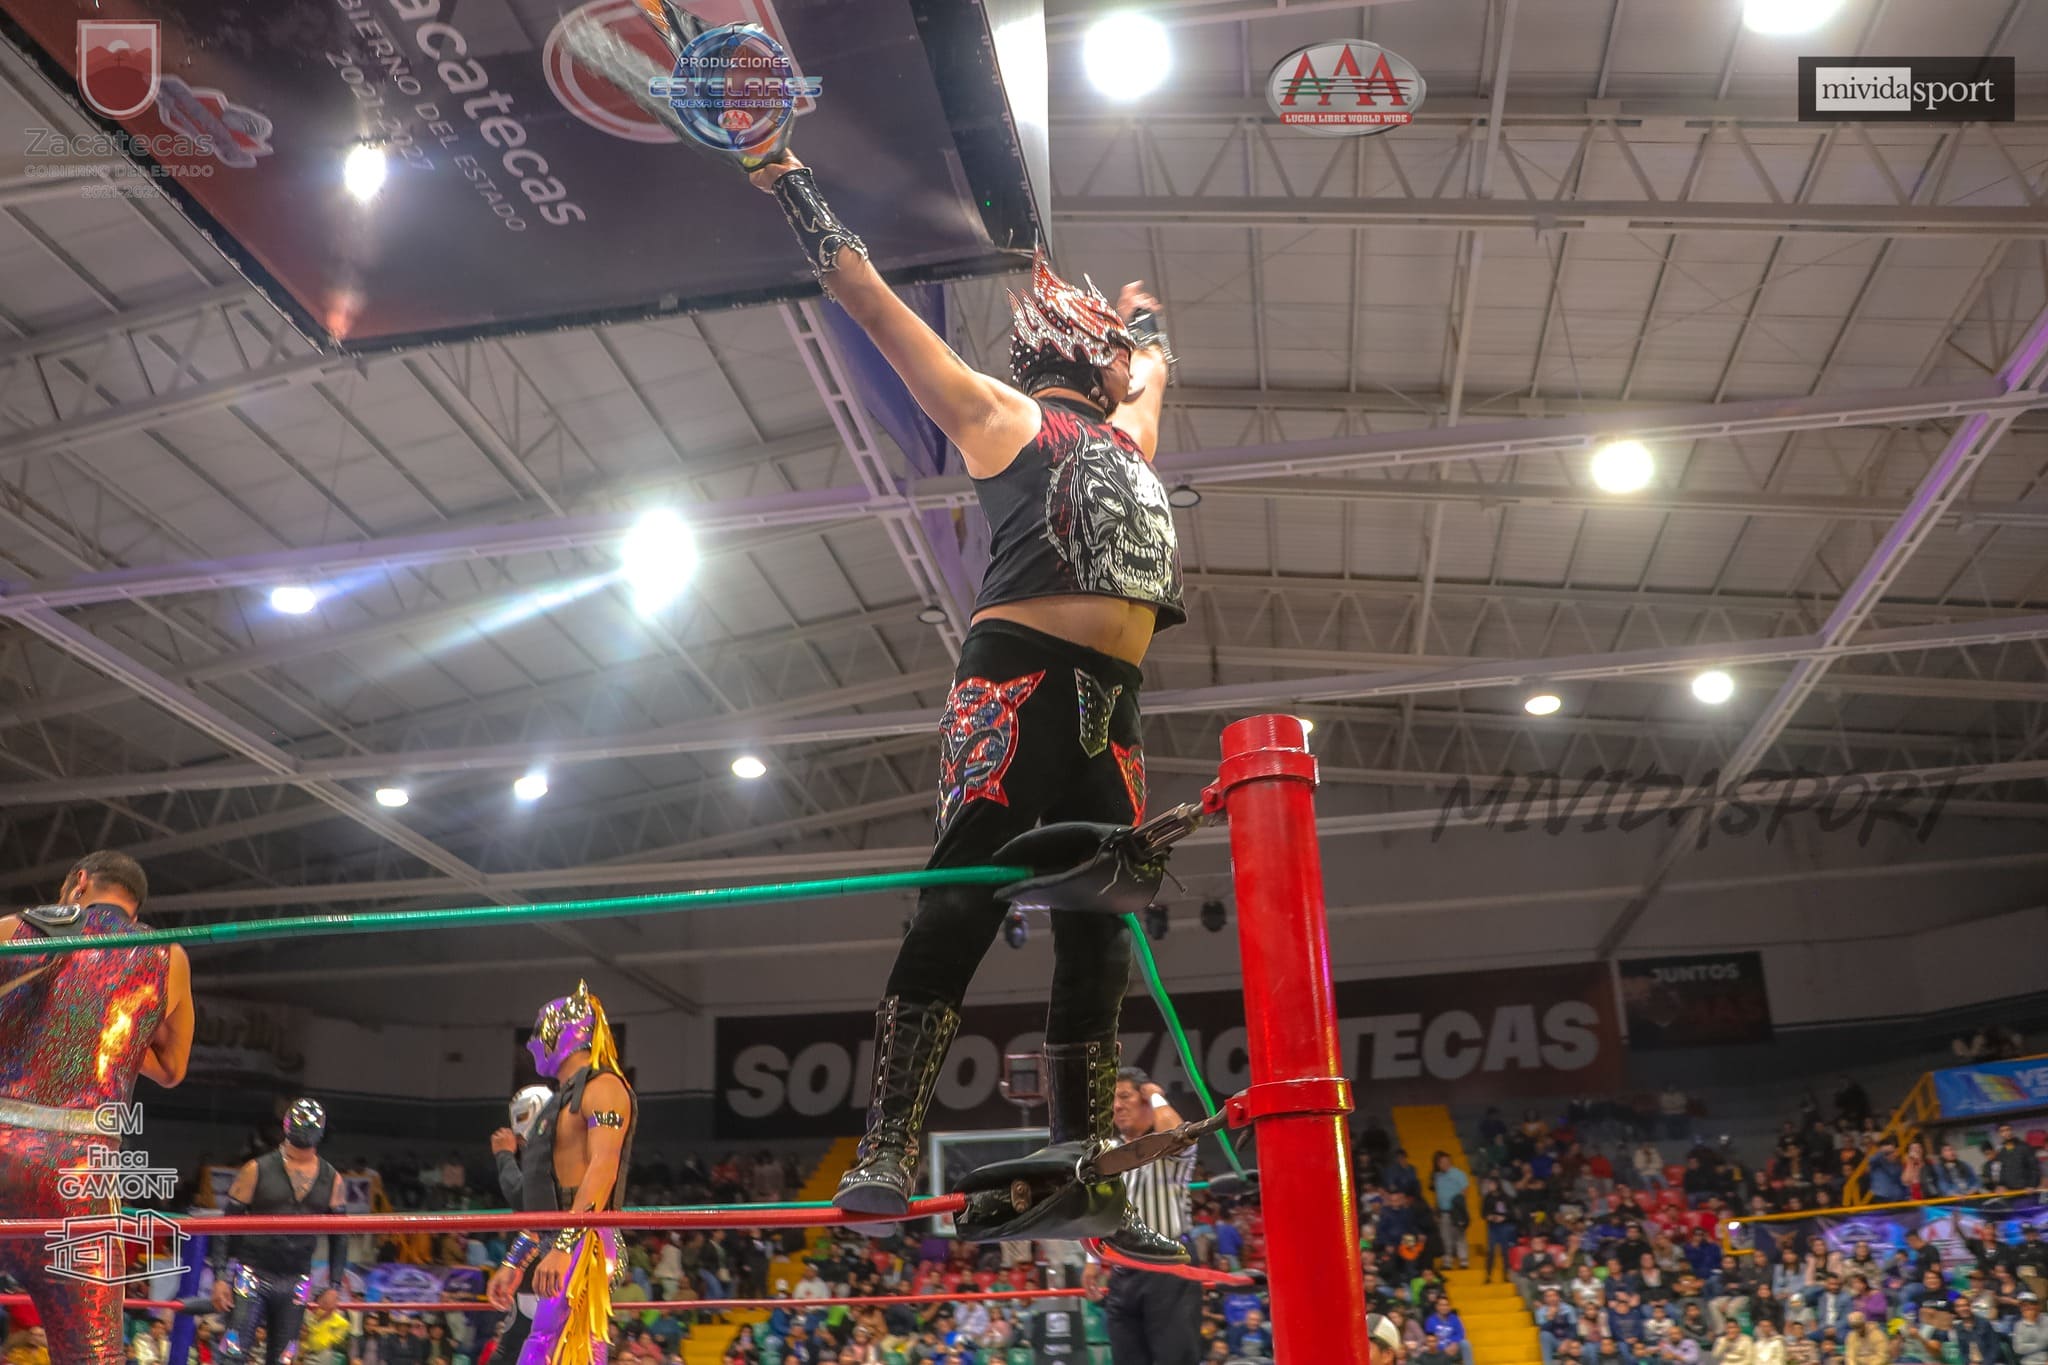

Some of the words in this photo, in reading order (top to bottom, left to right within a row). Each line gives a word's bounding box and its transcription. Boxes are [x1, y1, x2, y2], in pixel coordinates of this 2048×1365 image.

[415, 102, 459, 150] DEL
[453, 154, 527, 232] ESTADO
[1651, 957, 1740, 984] JUNTOS
